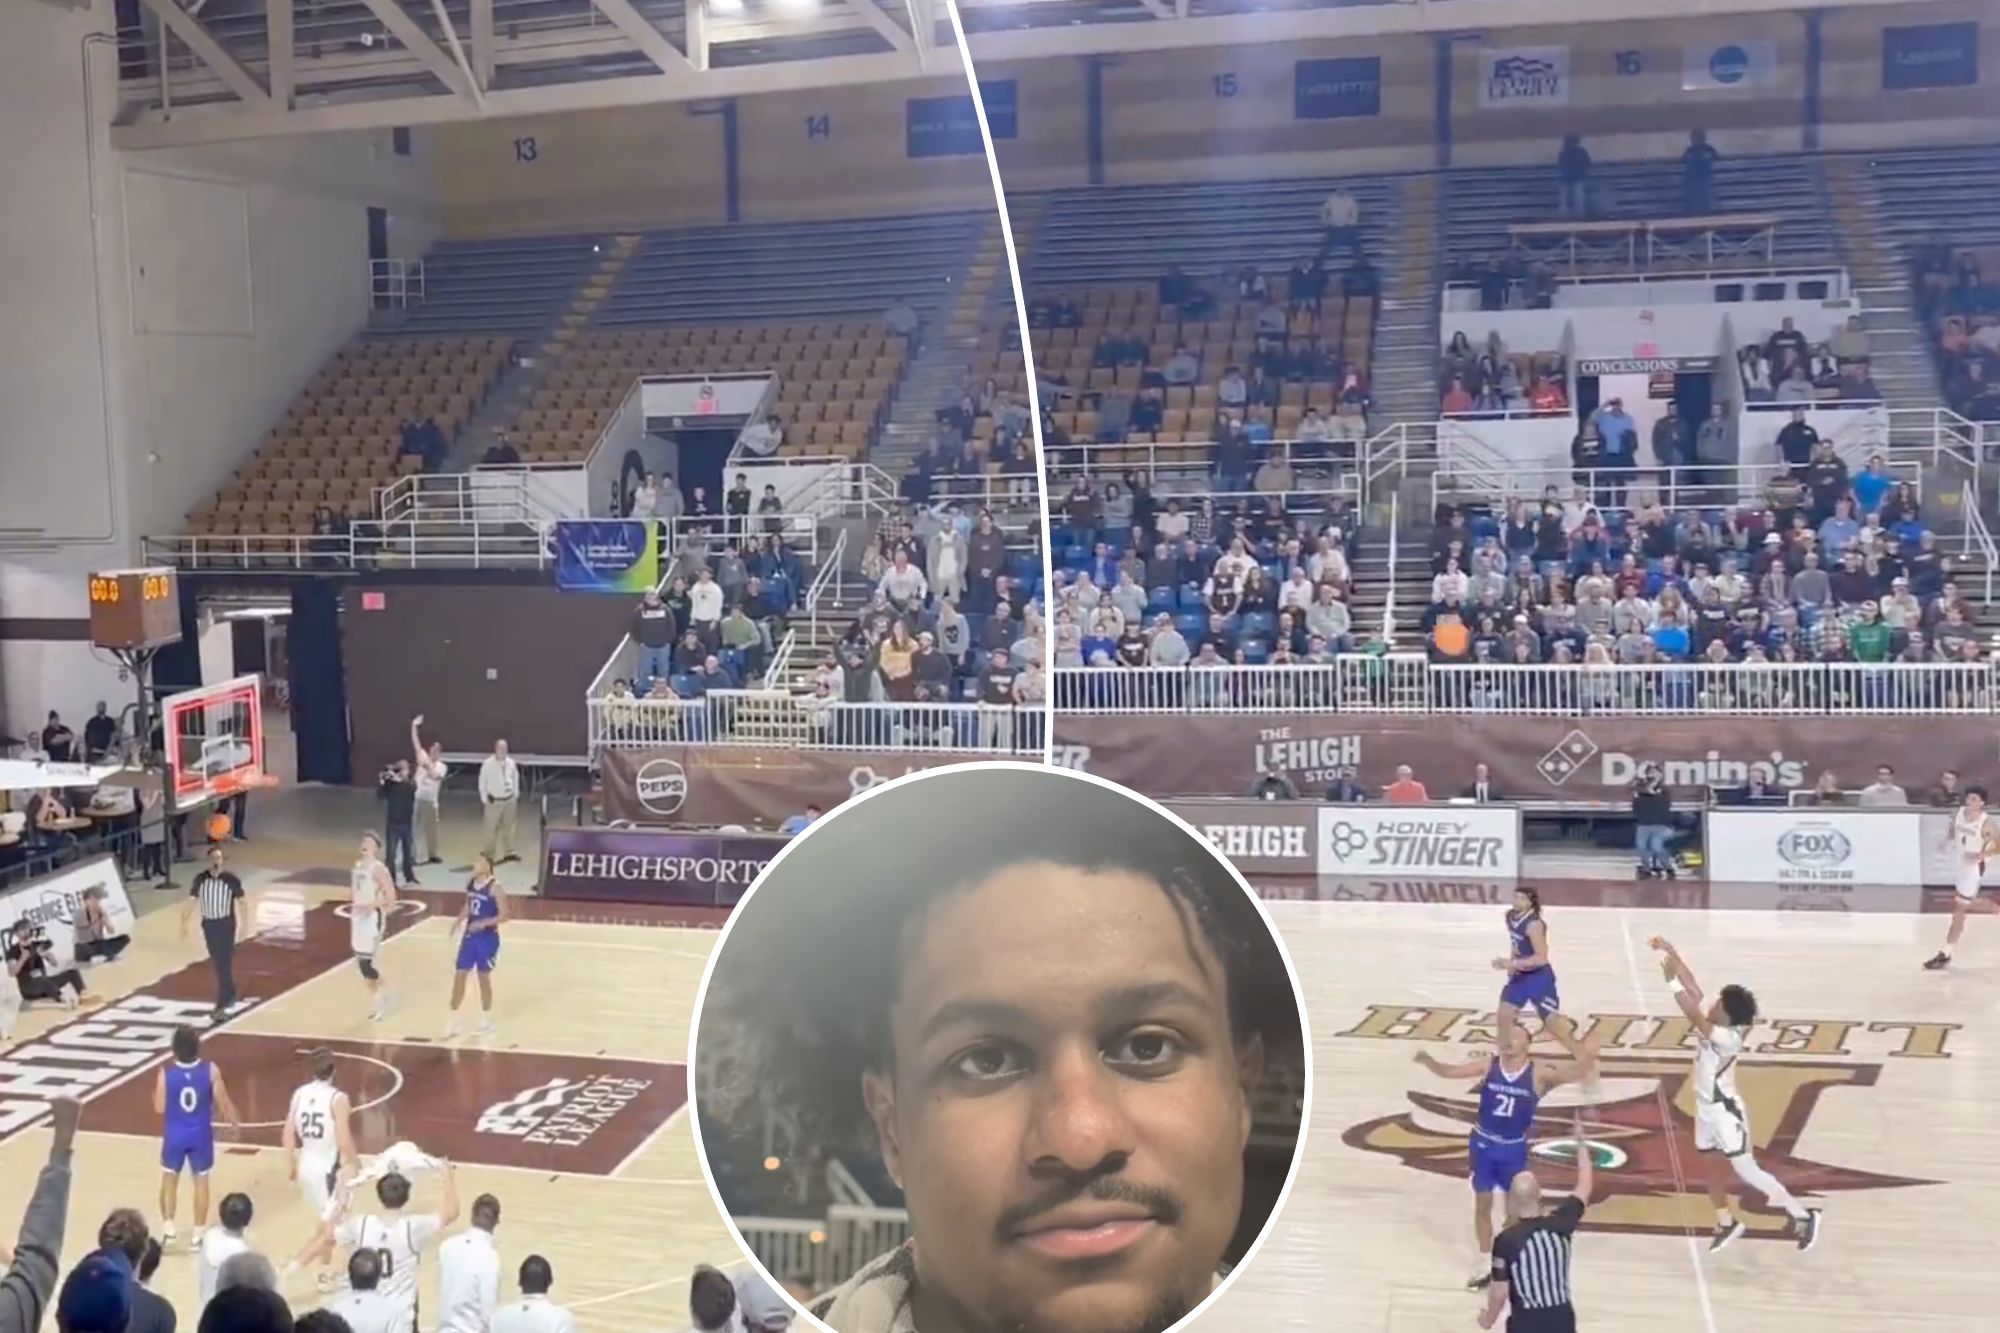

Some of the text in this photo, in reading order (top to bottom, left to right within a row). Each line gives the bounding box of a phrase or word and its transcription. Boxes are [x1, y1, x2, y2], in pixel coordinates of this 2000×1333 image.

[1212, 73, 1238, 98] 15
[804, 114, 831, 139] 14
[513, 136, 537, 162] 13
[1581, 359, 1679, 374] CONCESSIONS
[1260, 727, 1292, 741] THE
[1255, 735, 1362, 773] LEHIGH
[640, 780, 684, 793] PEPSI
[1376, 821, 1469, 835] HONEY
[1193, 824, 1310, 858] EHIGH
[1370, 836, 1504, 867] STINGER
[1792, 834, 1835, 853] FOX
[179, 1086, 198, 1113] 0
[522, 1073, 625, 1145] PATRIOT
[552, 1077, 653, 1147] LEAGUE
[1492, 1093, 1516, 1118] 21
[301, 1111, 325, 1140] 25
